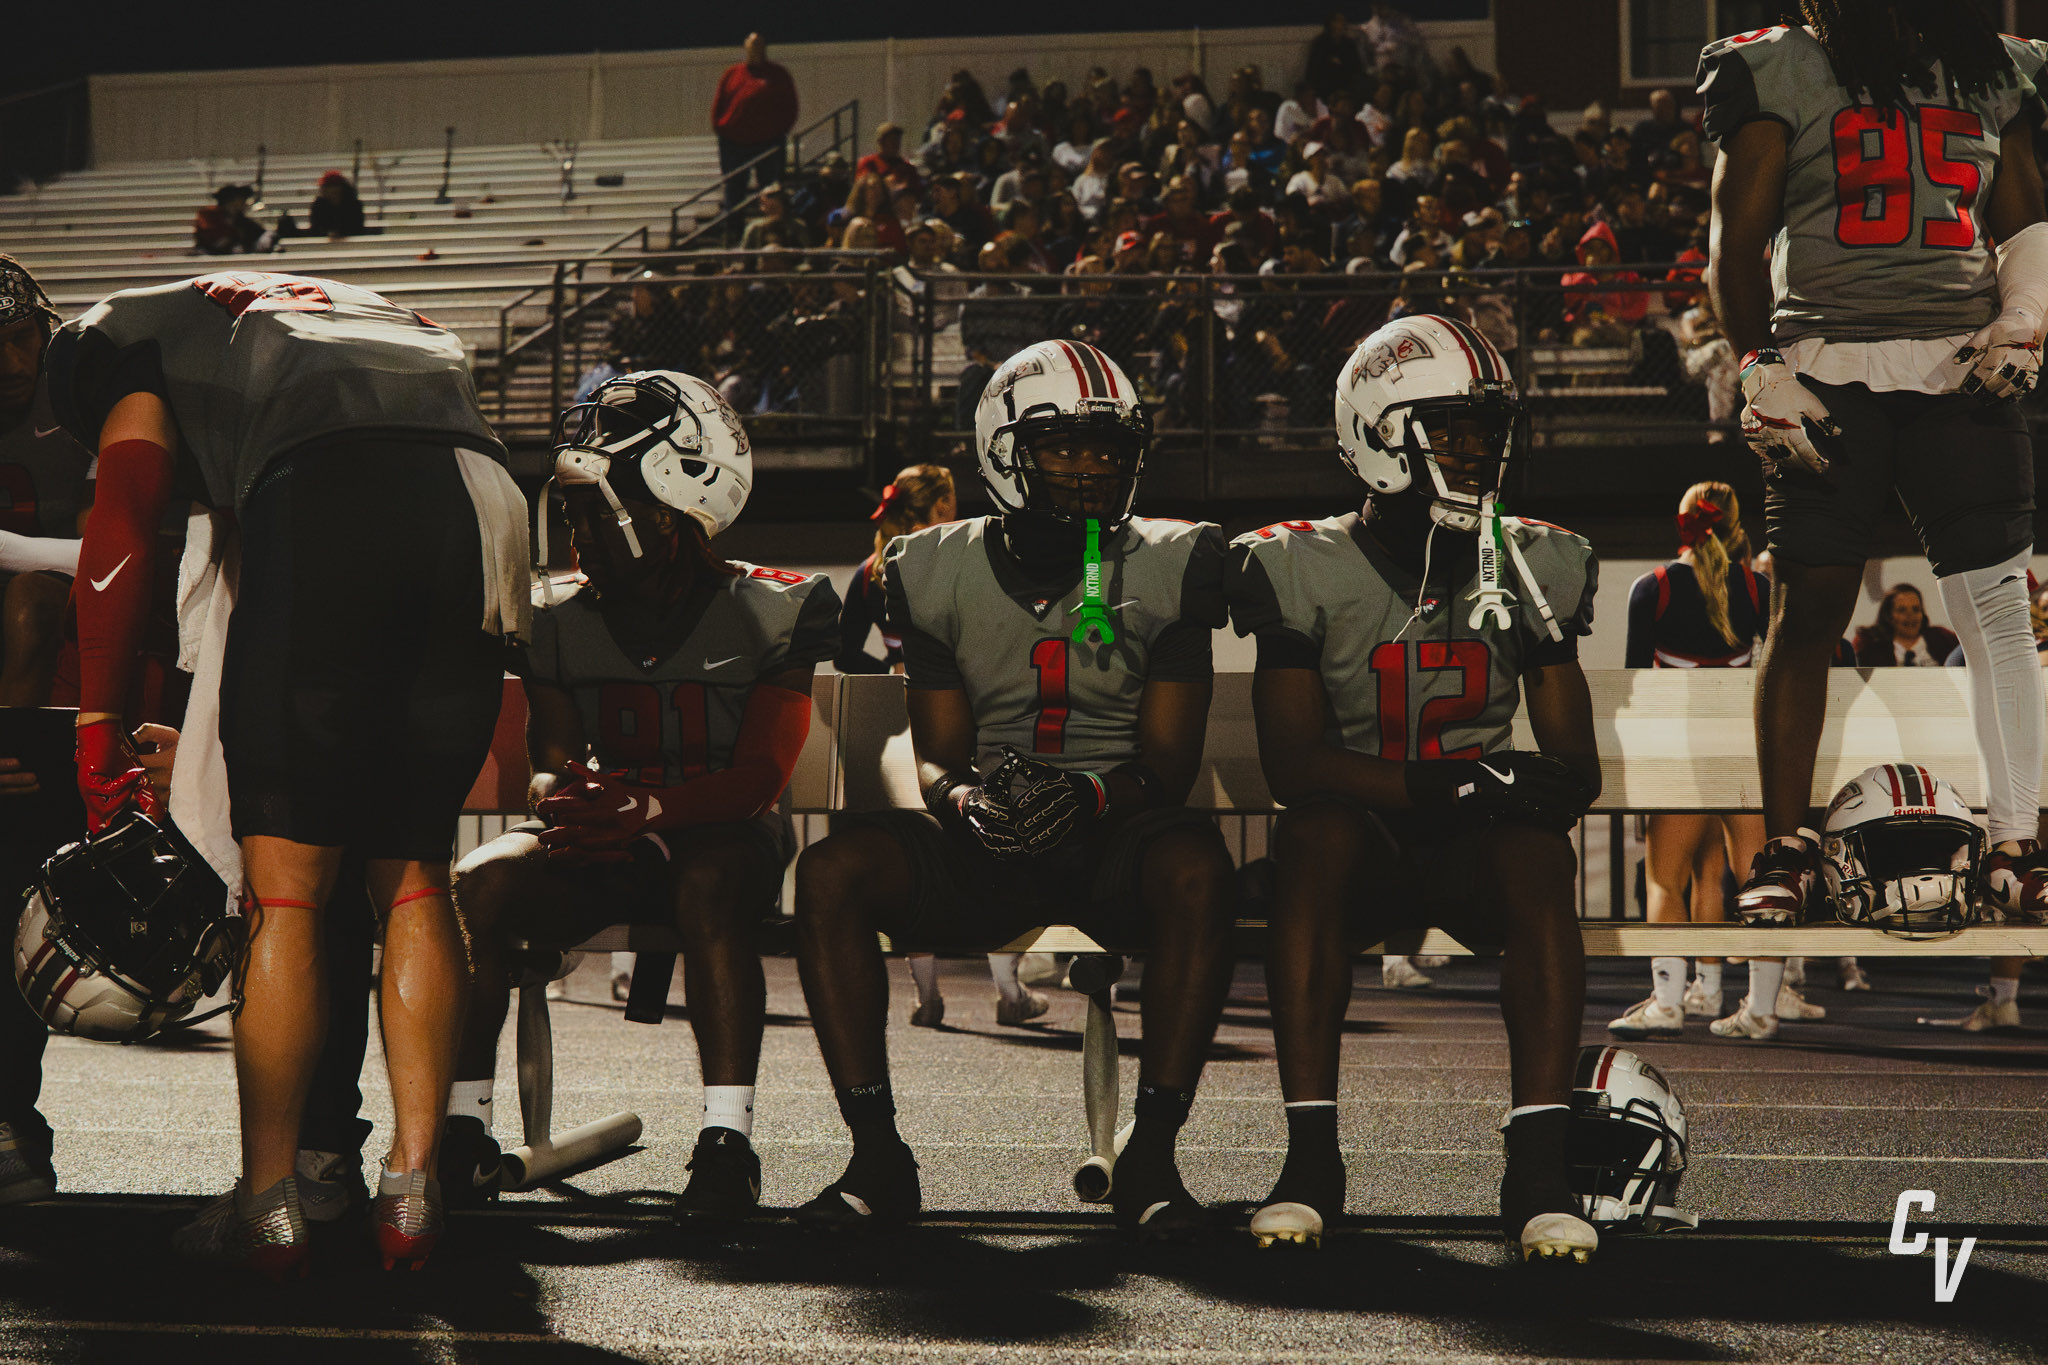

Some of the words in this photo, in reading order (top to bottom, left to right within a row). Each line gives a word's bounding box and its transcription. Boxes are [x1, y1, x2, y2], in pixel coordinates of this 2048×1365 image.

[1831, 103, 1985, 250] 85
[1086, 562, 1100, 597] NXTRND
[1481, 548, 1495, 582] NXTRND
[1029, 637, 1069, 754] 1
[1368, 639, 1491, 761] 12
[1894, 807, 1937, 816] Riddell
